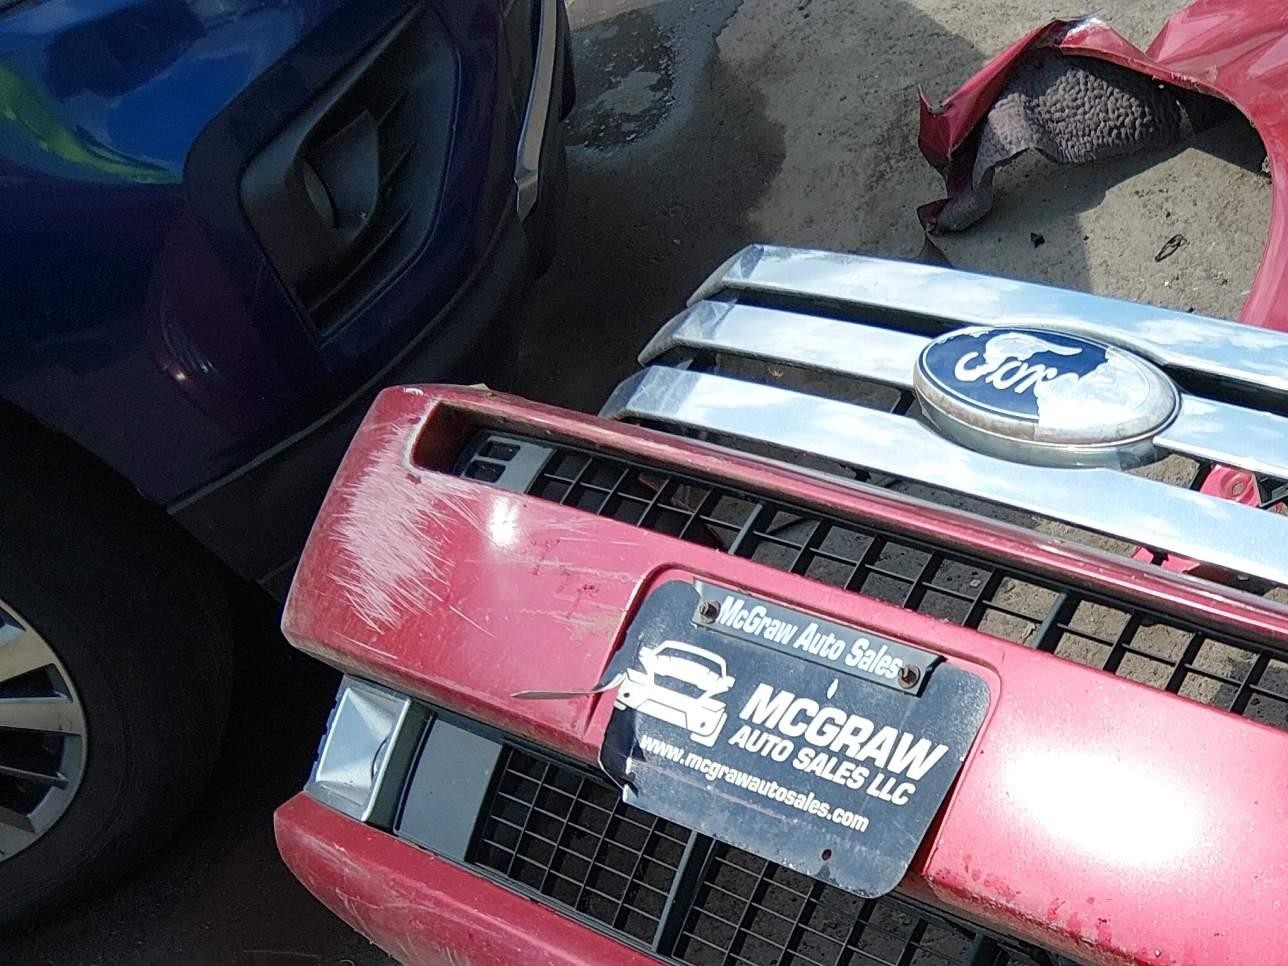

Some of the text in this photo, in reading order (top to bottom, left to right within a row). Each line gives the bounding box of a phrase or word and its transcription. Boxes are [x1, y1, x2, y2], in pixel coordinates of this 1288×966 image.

[954, 332, 1084, 395] For
[718, 595, 902, 681] McGraw Auto Sales
[728, 725, 917, 806] AUTO SALES LLC
[738, 683, 949, 782] MCGRAW
[638, 734, 870, 833] www.mcgrawautosales.com
